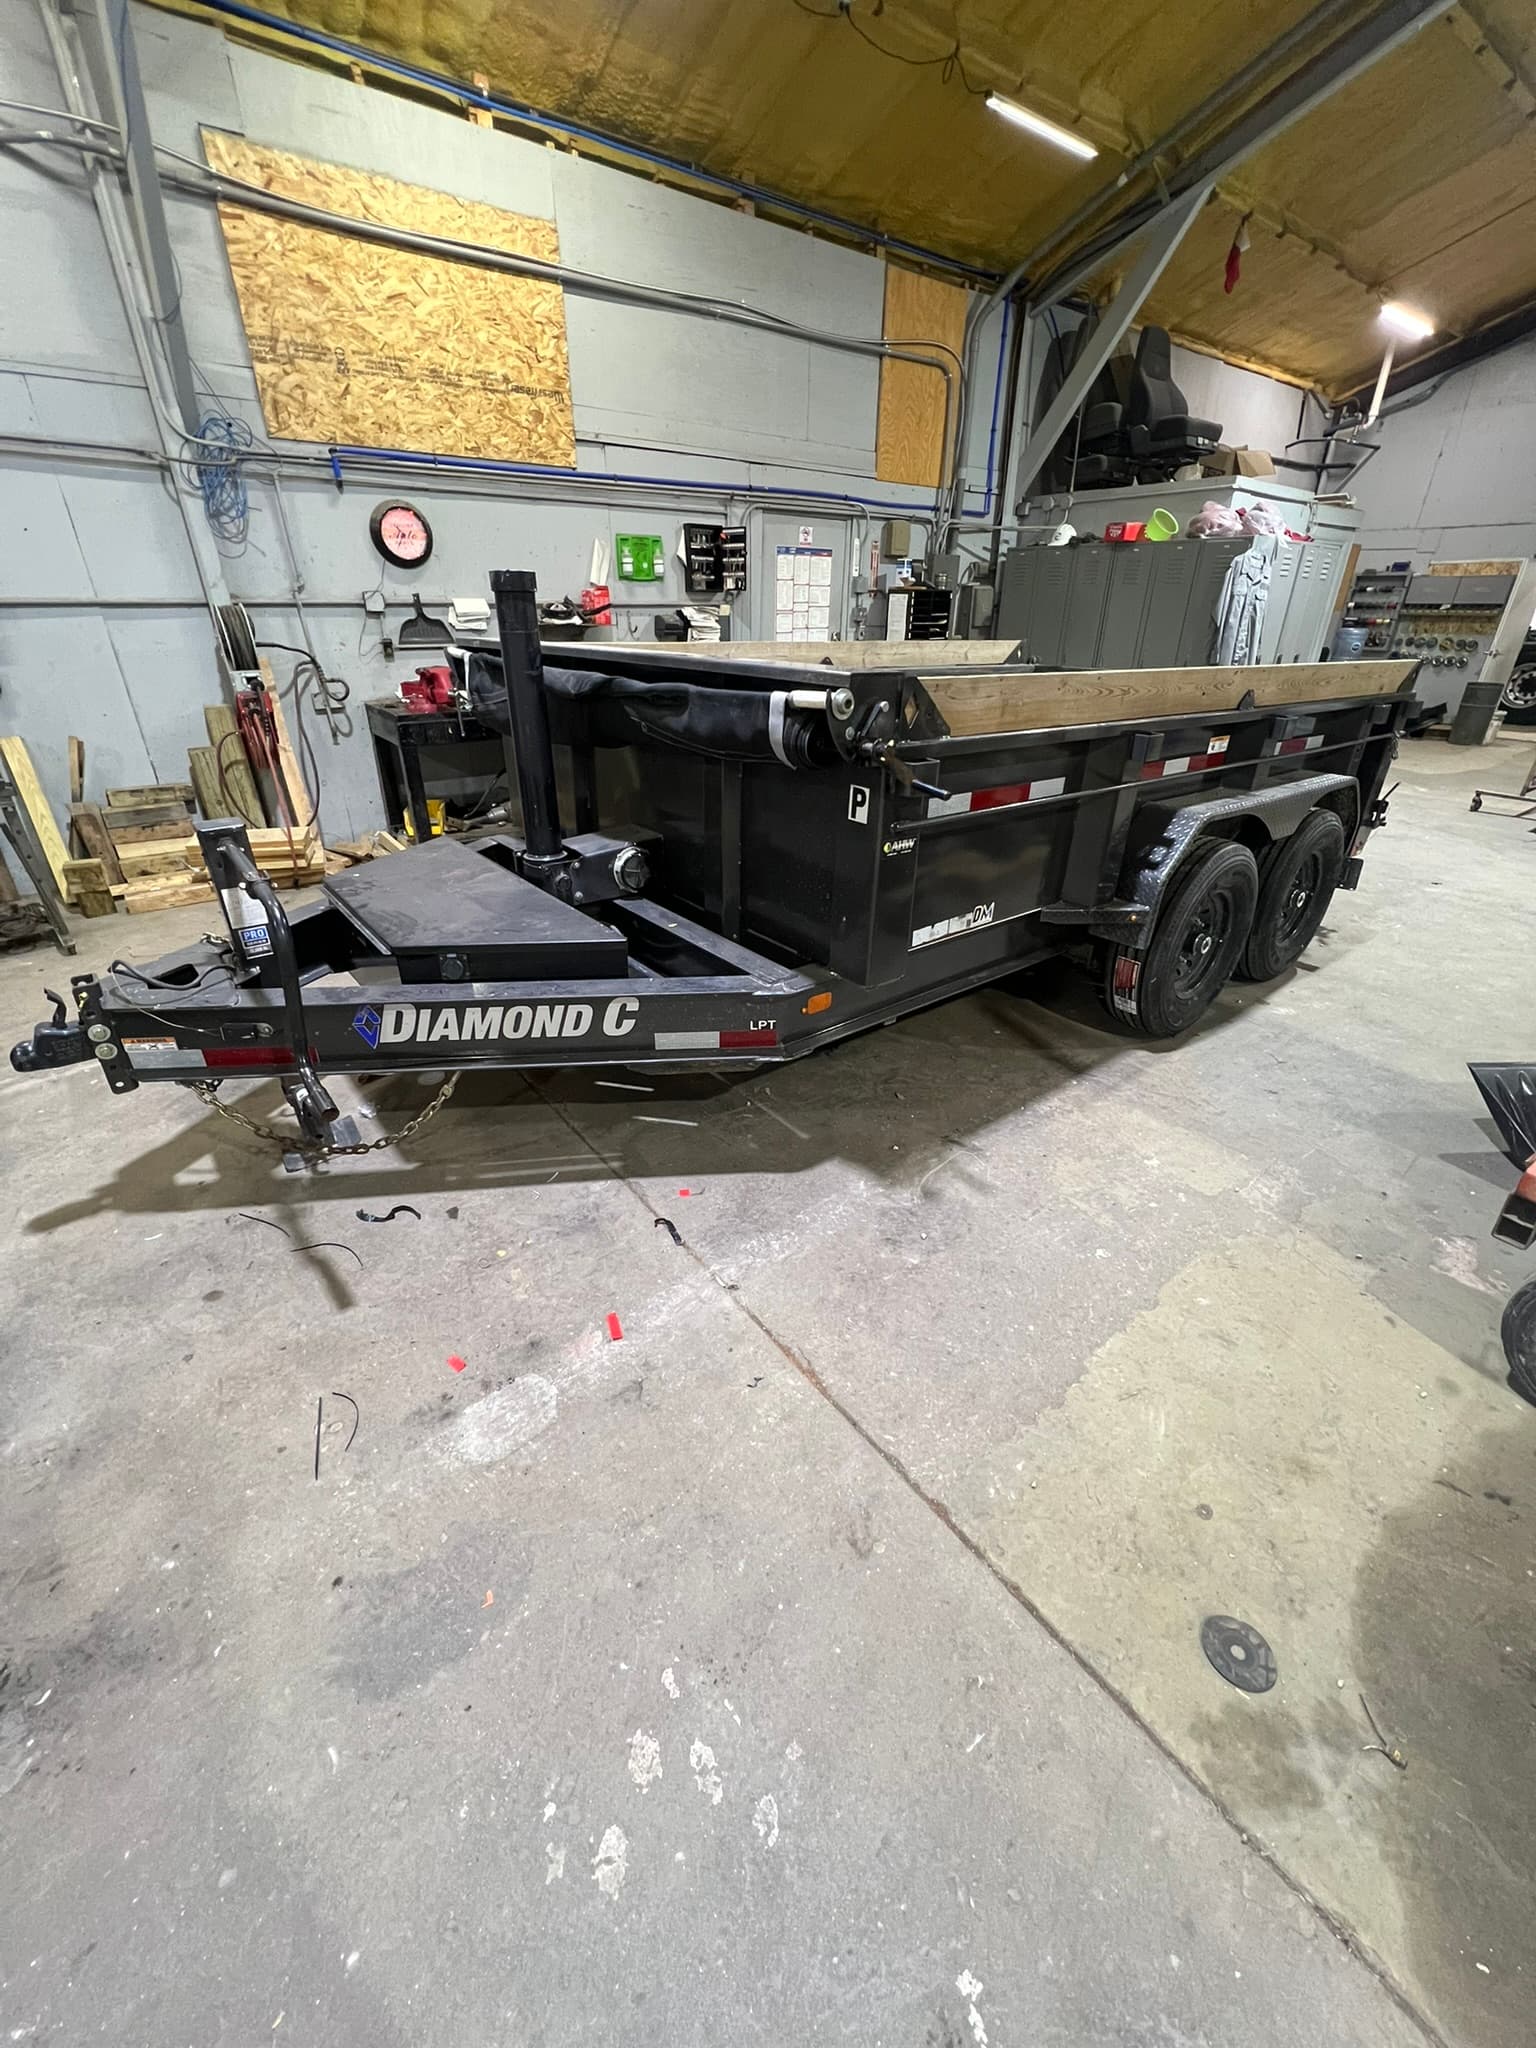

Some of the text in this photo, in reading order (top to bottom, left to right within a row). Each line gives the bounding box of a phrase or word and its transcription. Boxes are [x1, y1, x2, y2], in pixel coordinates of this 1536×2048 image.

[850, 785, 867, 820] P
[243, 929, 265, 940] PRO
[379, 996, 639, 1043] DIAMOND C
[750, 1020, 777, 1030] LPT
